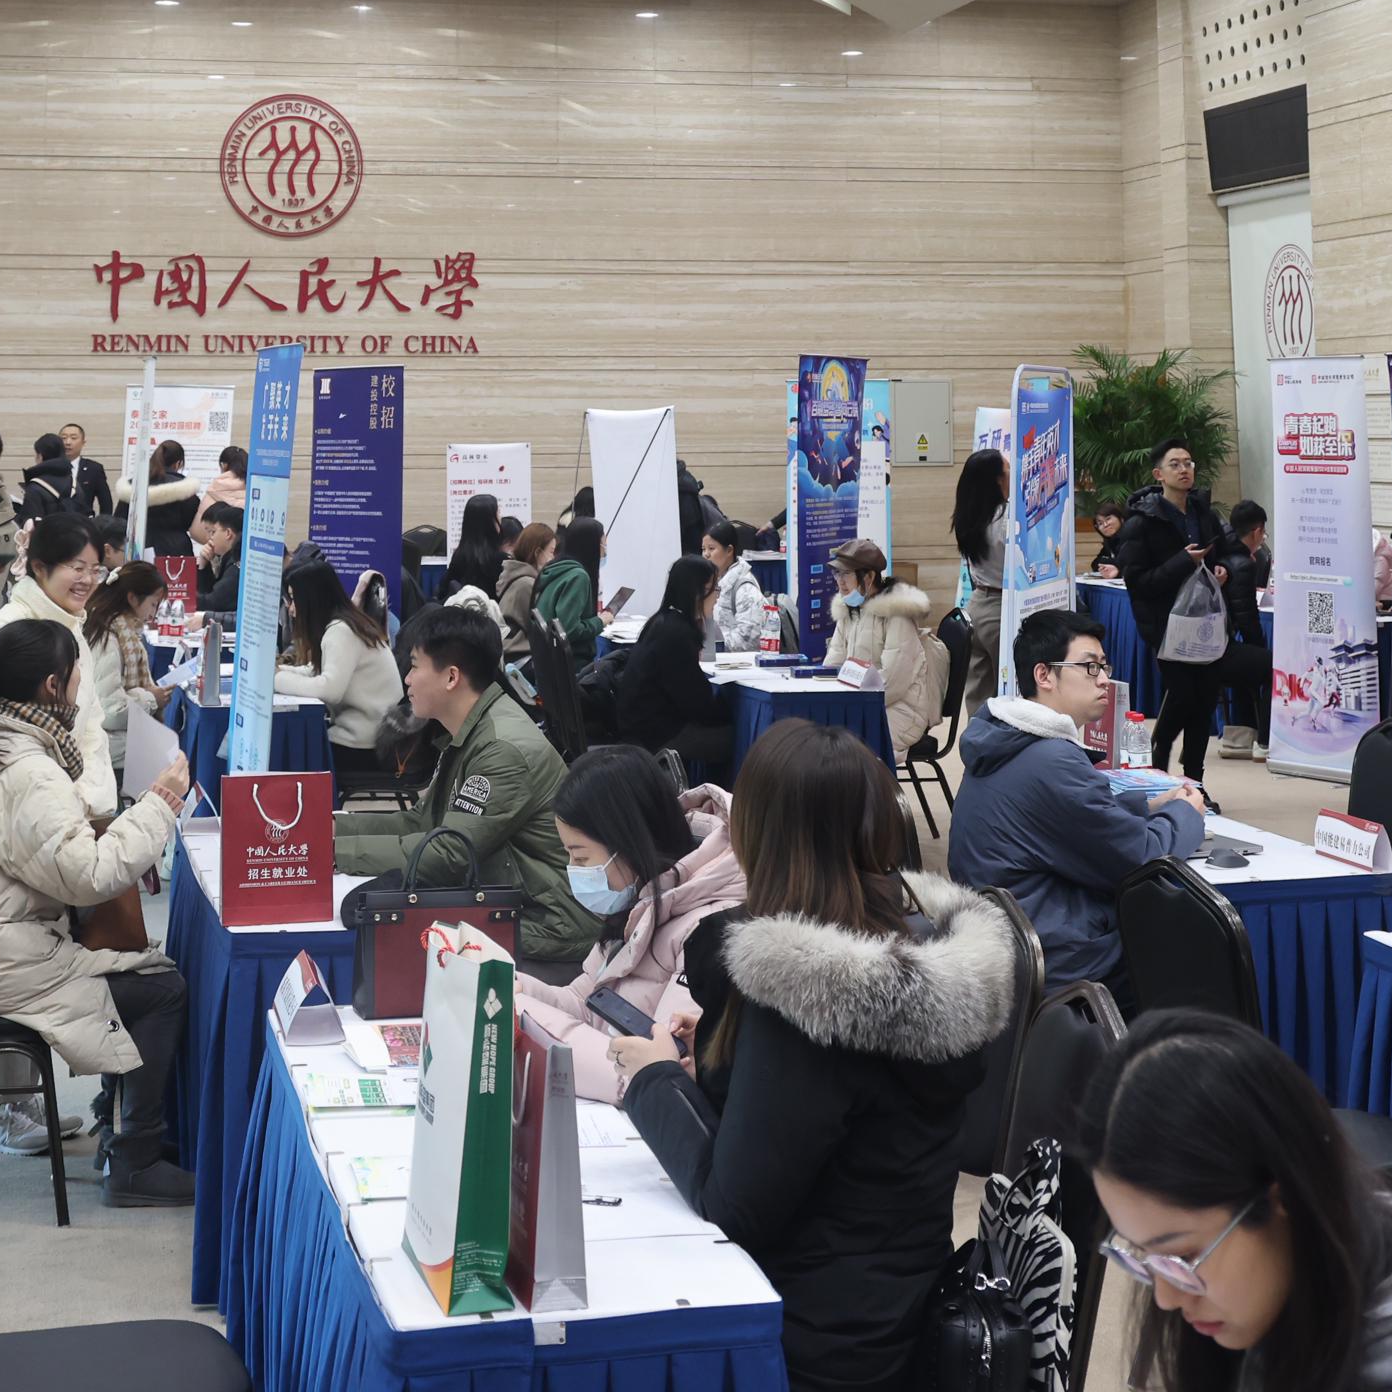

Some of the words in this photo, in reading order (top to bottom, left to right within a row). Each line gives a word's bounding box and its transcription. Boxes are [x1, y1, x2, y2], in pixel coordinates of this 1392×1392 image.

[226, 129, 247, 186] RENMIN
[243, 102, 328, 131] UNIVERSITY
[328, 120, 345, 137] OF
[341, 140, 357, 186] CHINA
[281, 198, 306, 208] 1937
[91, 334, 191, 354] RENMIN
[203, 334, 350, 354] UNIVERSITY
[360, 334, 393, 354] OF
[403, 334, 480, 354] CHINA
[381, 374, 396, 429] 校招
[1285, 415, 1337, 435] 青春起跑
[1300, 430, 1353, 457] 如获至保
[248, 865, 308, 880] 招生就业处
[490, 1023, 498, 1043] NEW
[489, 1043, 497, 1067] HOPE
[488, 1068, 496, 1095] GROUP
